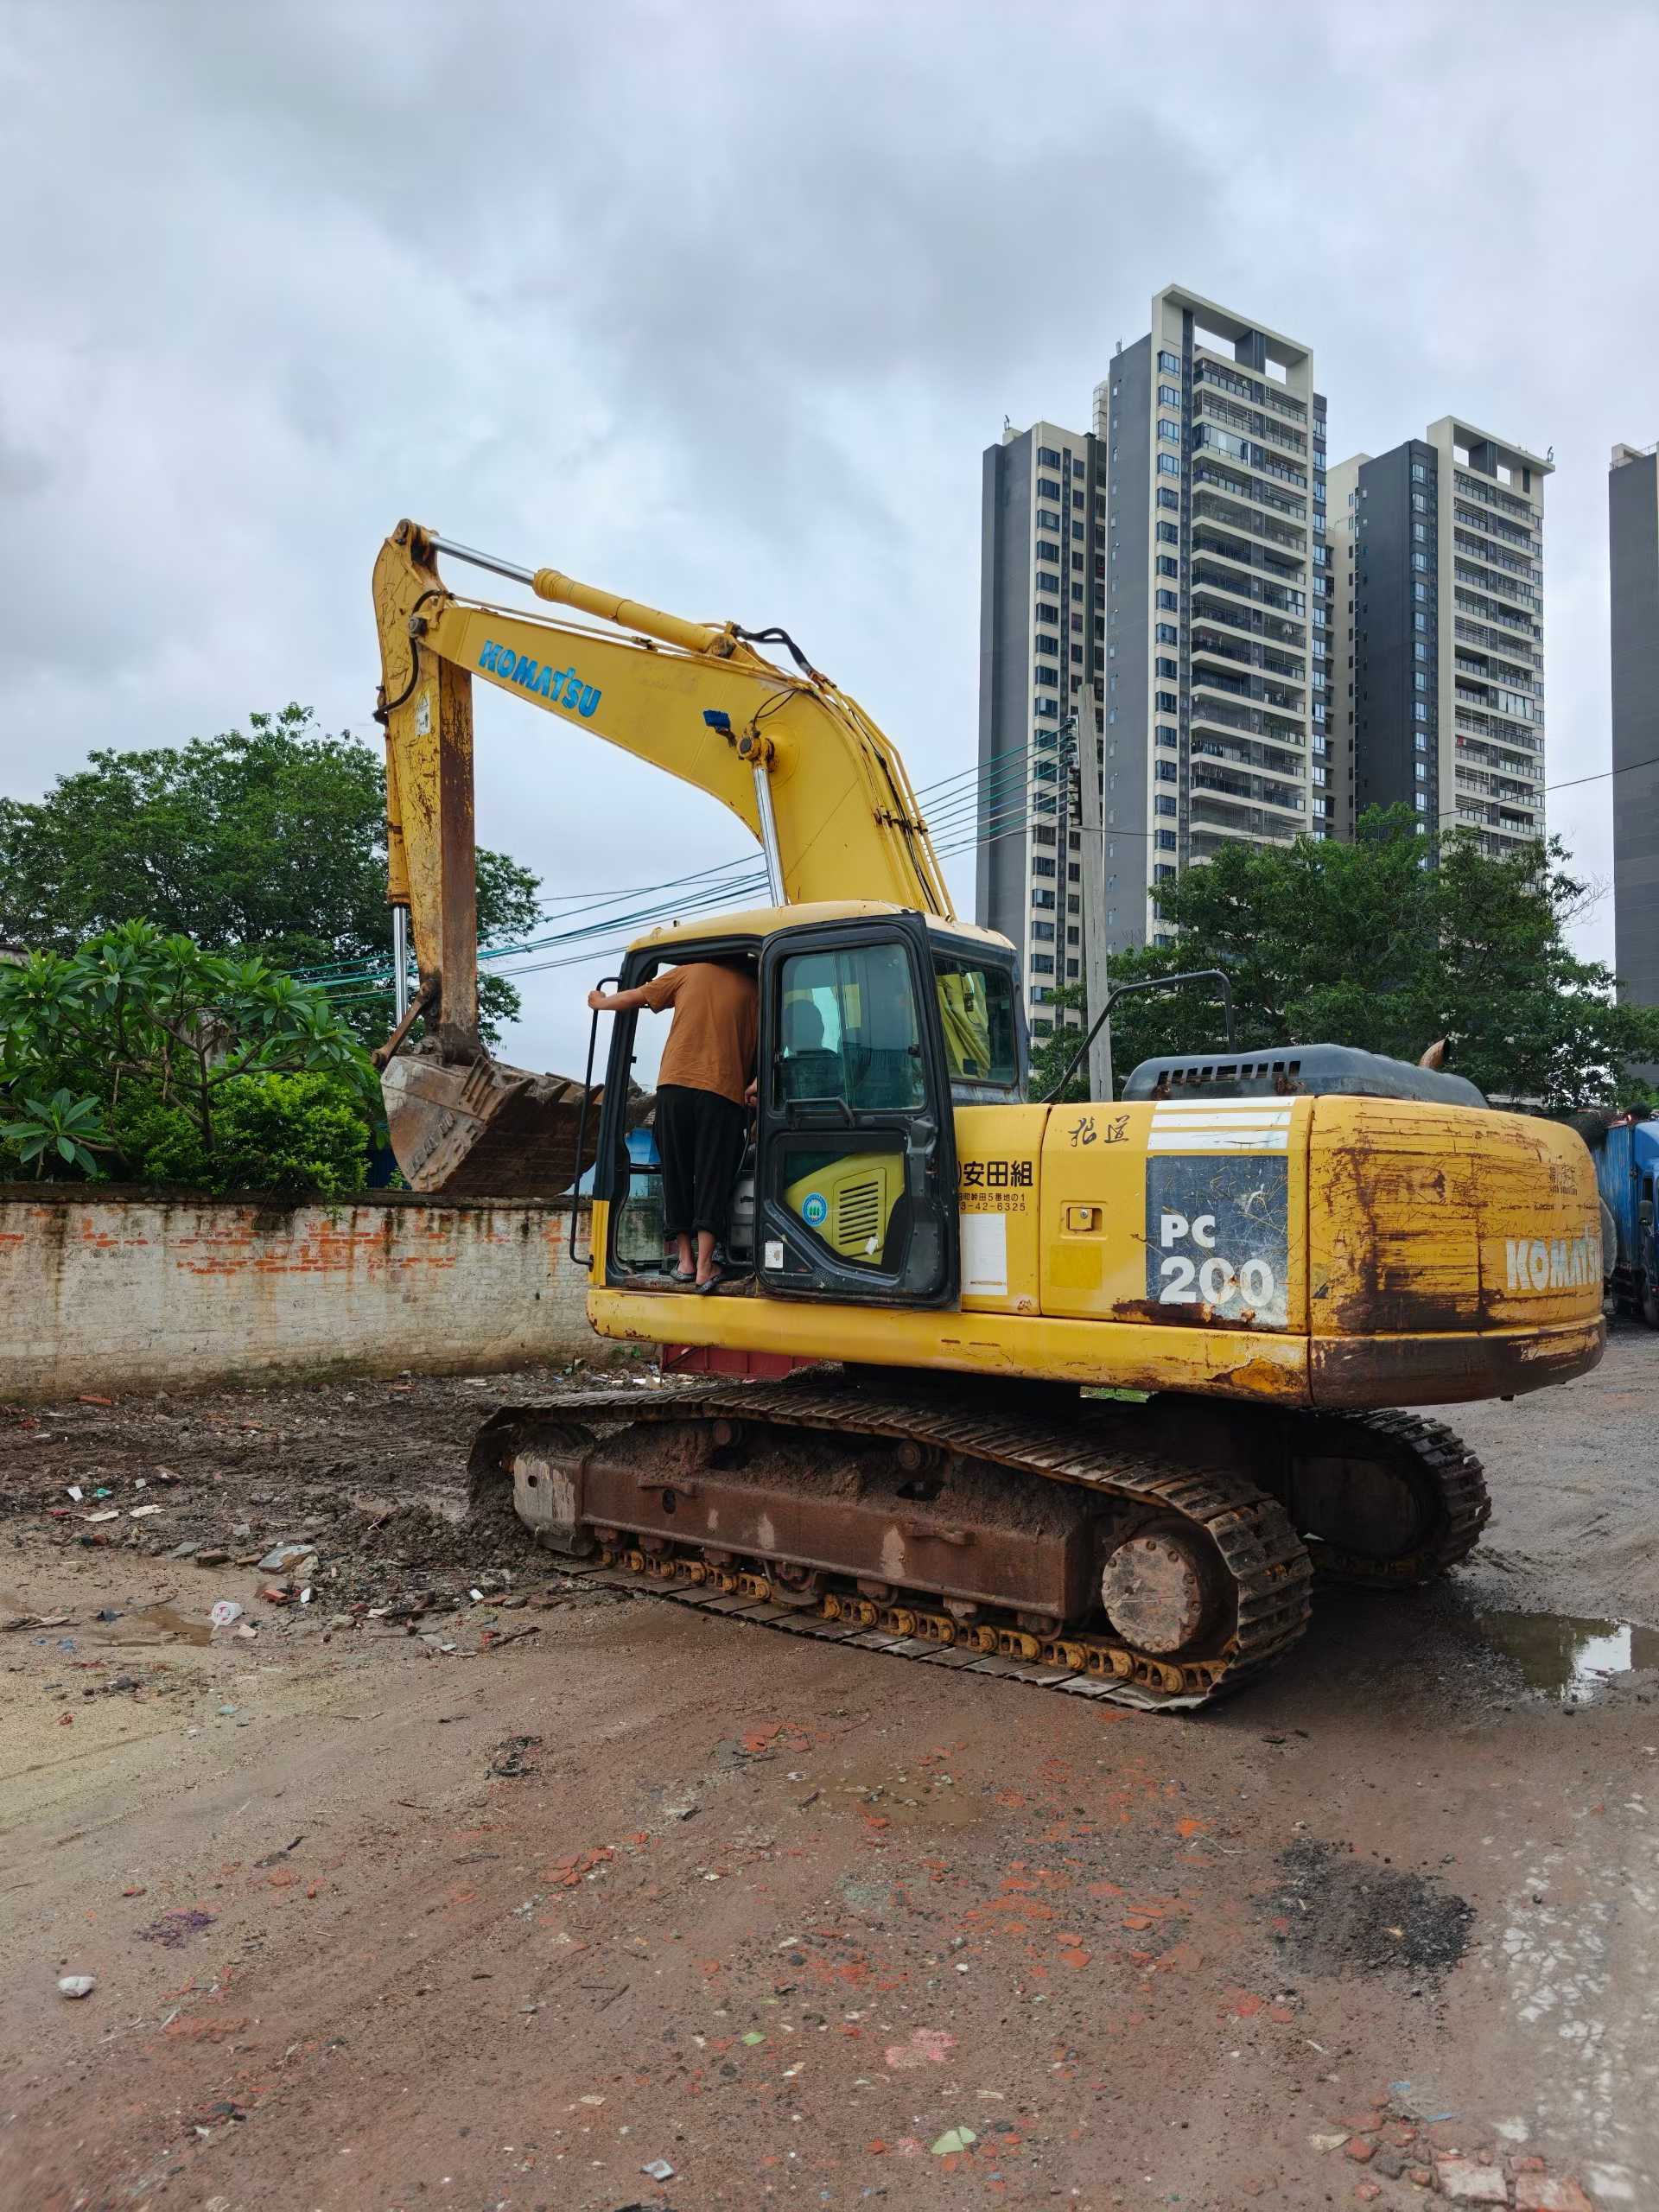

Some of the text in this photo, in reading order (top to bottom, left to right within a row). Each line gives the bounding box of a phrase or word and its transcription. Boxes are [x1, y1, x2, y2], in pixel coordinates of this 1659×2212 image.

[478, 639, 602, 718] KOMATSU
[1160, 1214, 1216, 1249] PC
[1160, 1255, 1274, 1307] 200
